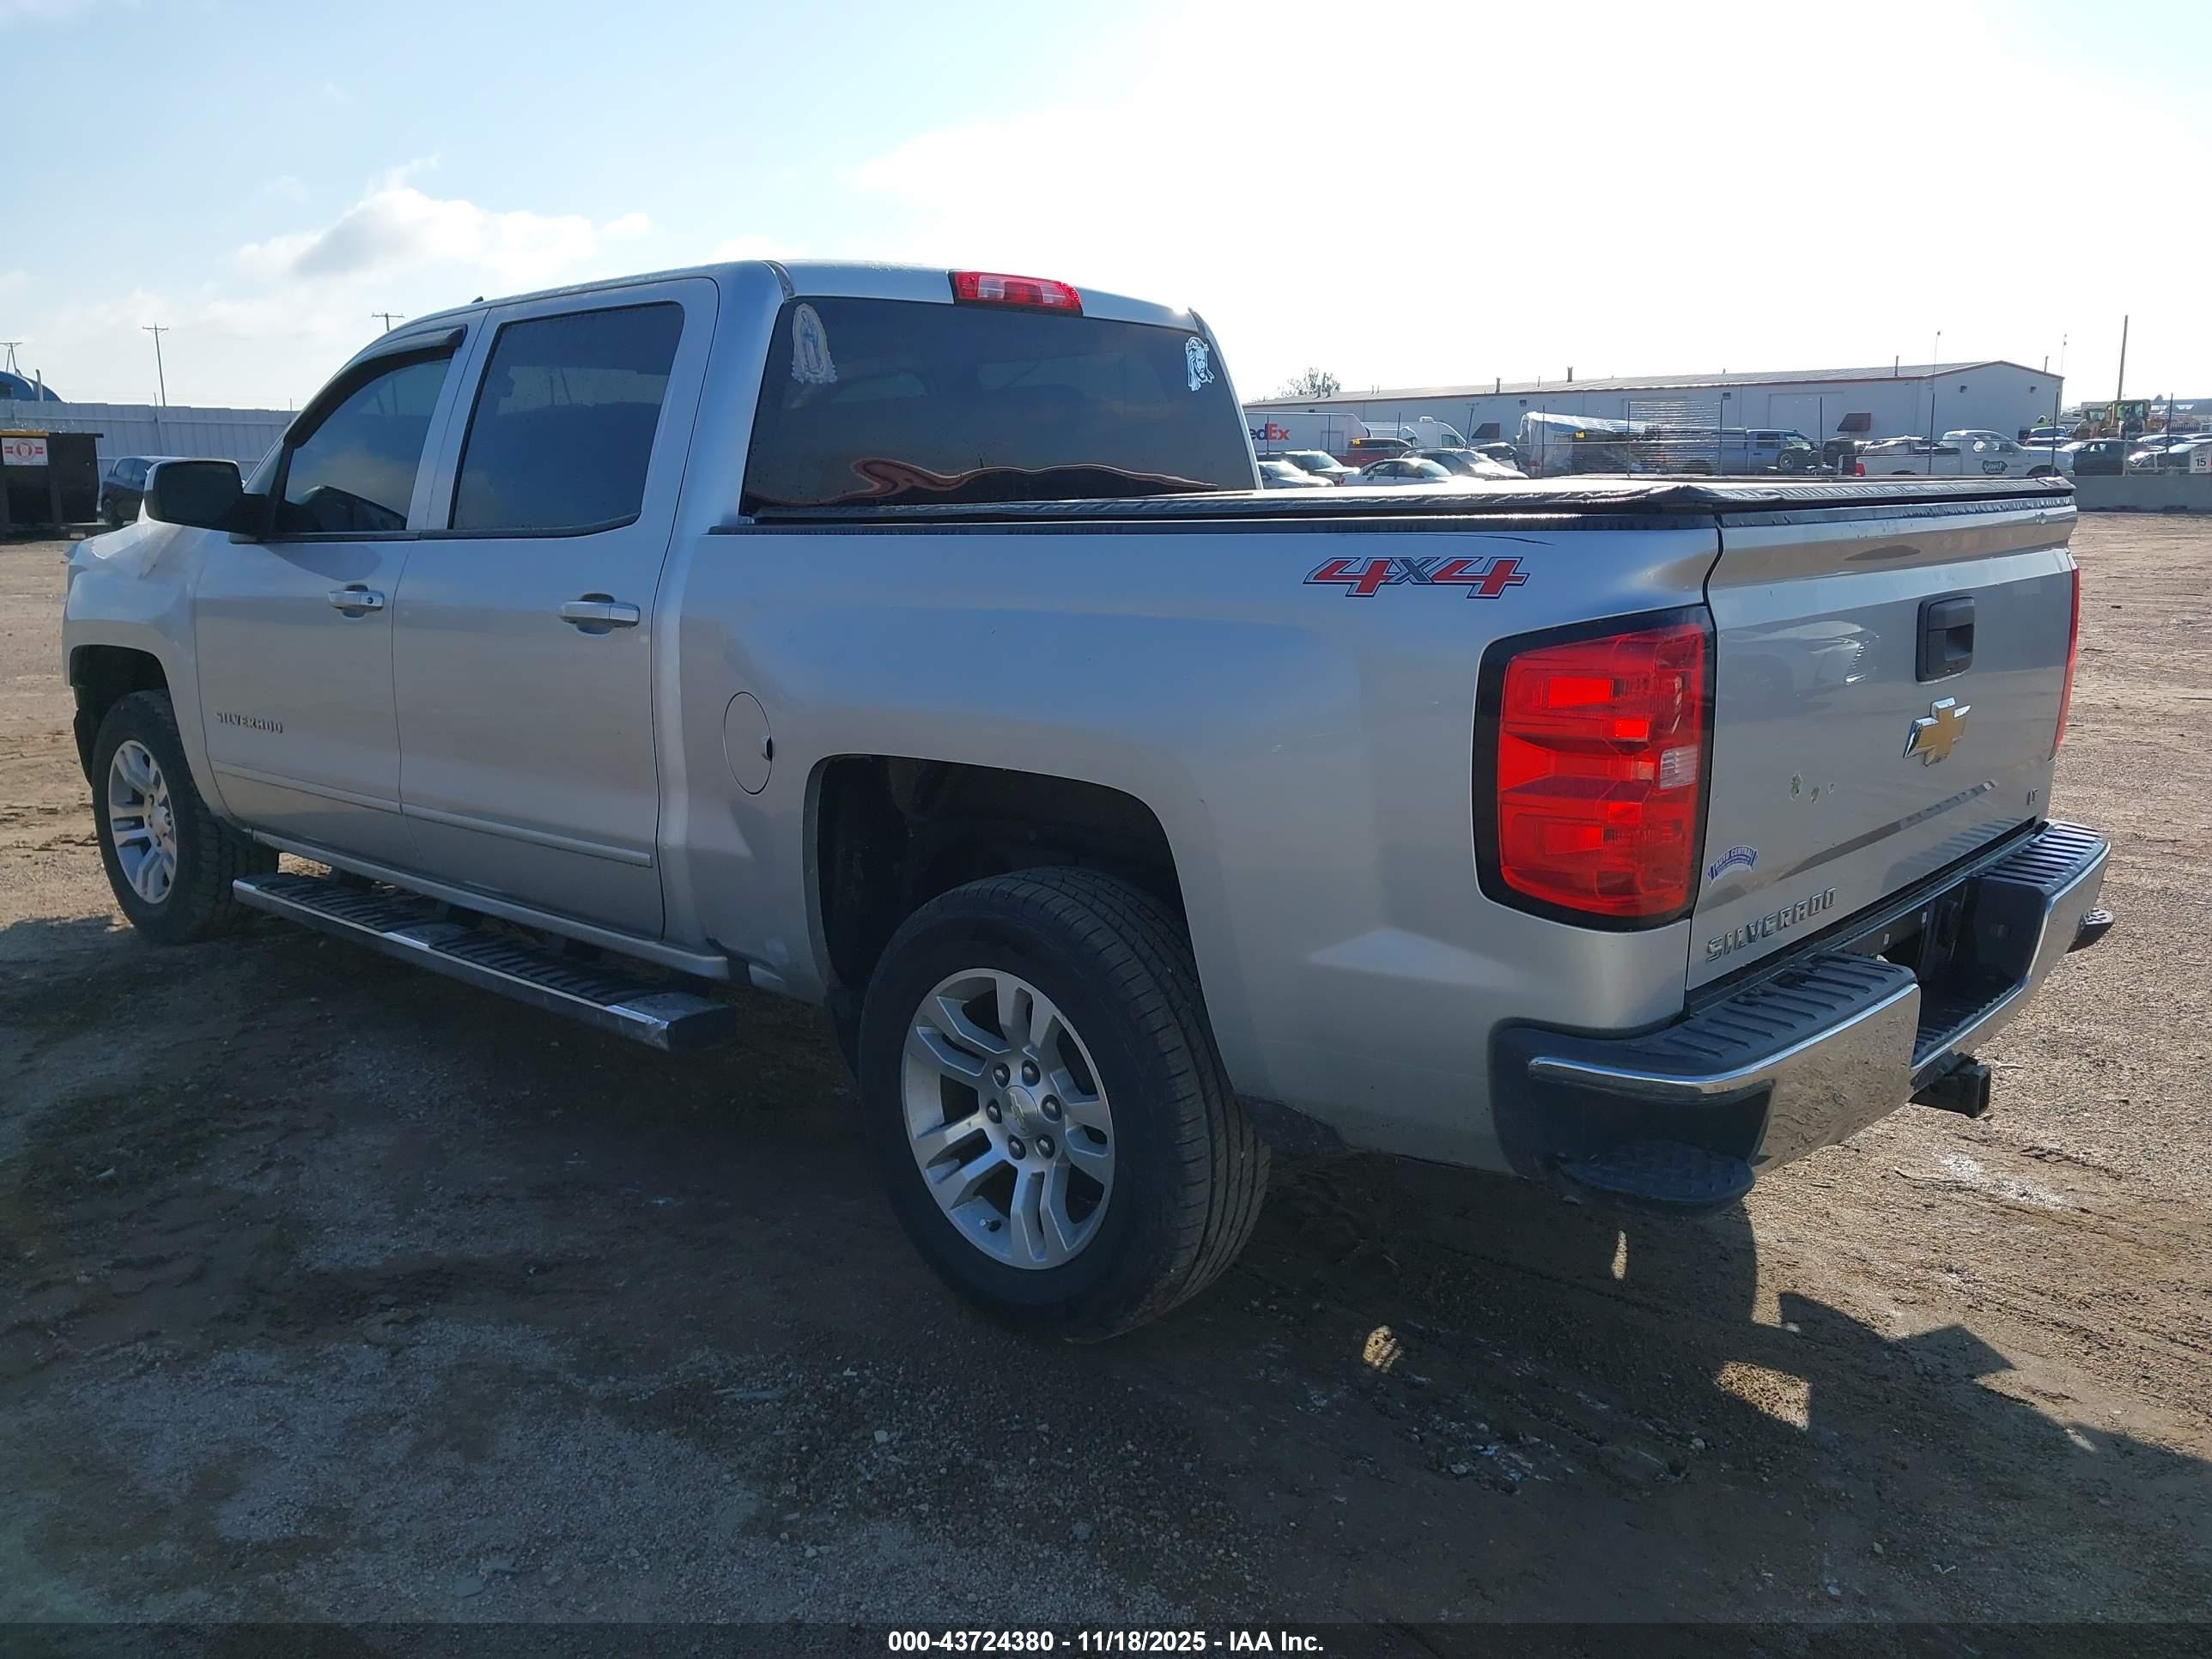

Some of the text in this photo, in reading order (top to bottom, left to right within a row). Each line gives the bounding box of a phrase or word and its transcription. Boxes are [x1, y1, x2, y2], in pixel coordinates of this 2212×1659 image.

[1249, 423, 1290, 441] edEx
[2195, 458, 2207, 467] 15
[216, 710, 283, 733] SILVERADO
[1715, 851, 1730, 868] AUTO
[1705, 887, 1837, 963] SILVERADO
